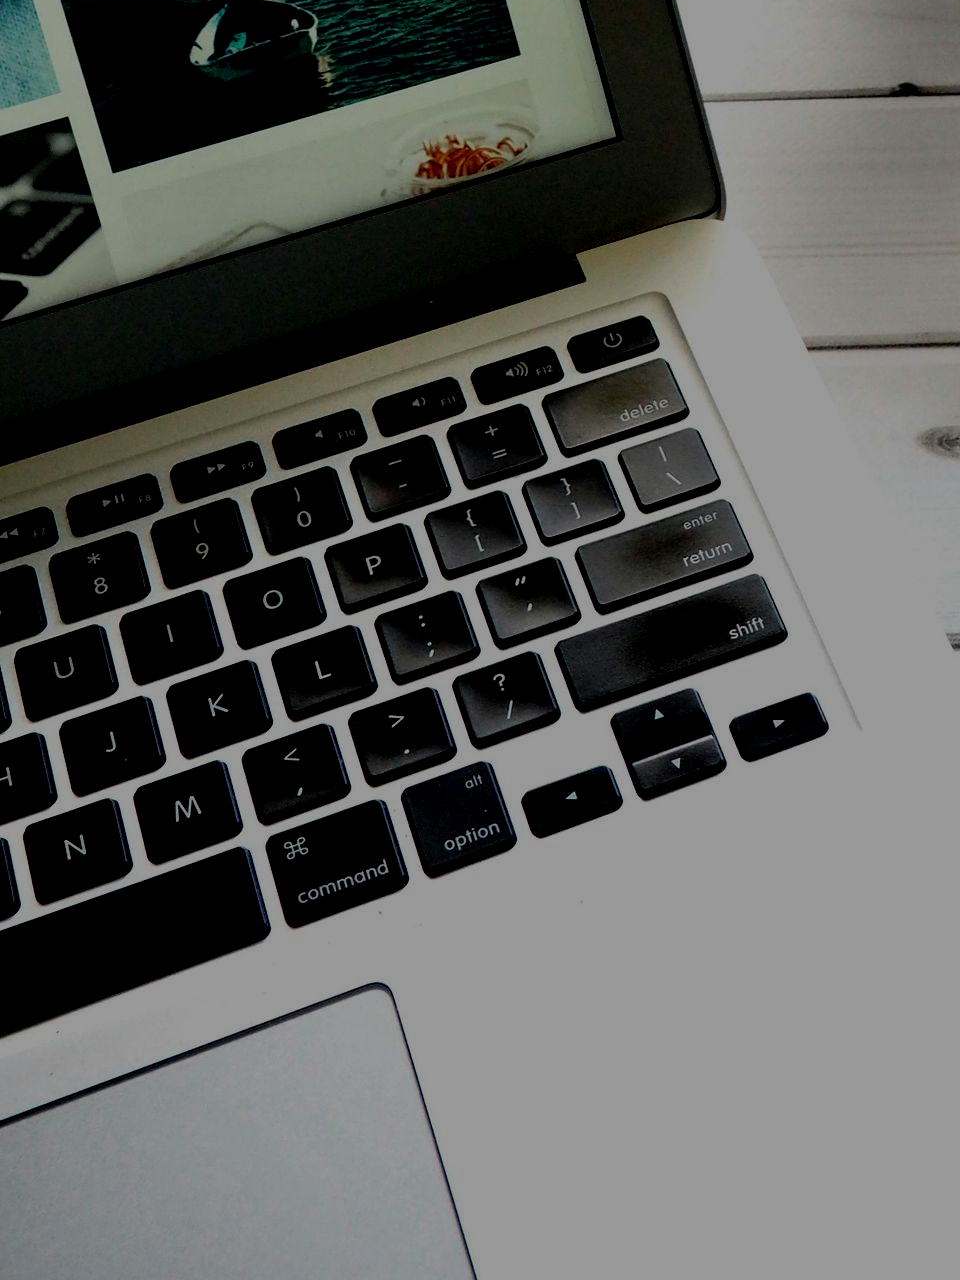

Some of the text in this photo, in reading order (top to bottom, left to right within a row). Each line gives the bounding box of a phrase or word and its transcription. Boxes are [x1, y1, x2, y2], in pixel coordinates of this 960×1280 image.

[535, 365, 552, 376] F12
[440, 396, 456, 406] F11
[619, 399, 671, 425] delete
[337, 429, 356, 440] F10
[241, 461, 254, 471] F9
[138, 496, 150, 504] F8
[681, 508, 717, 530] enter
[33, 527, 45, 536] F7
[195, 542, 209, 560] 9
[682, 542, 733, 569] return
[365, 555, 382, 576] P
[93, 577, 109, 595] 8
[728, 615, 766, 640] shift
[53, 656, 75, 679] U
[314, 660, 332, 680] L
[207, 693, 229, 717] K
[105, 731, 117, 753] J
[465, 774, 483, 789] alt
[174, 795, 202, 823] M
[442, 819, 501, 852] option
[63, 834, 87, 861] N
[296, 859, 391, 905] command
